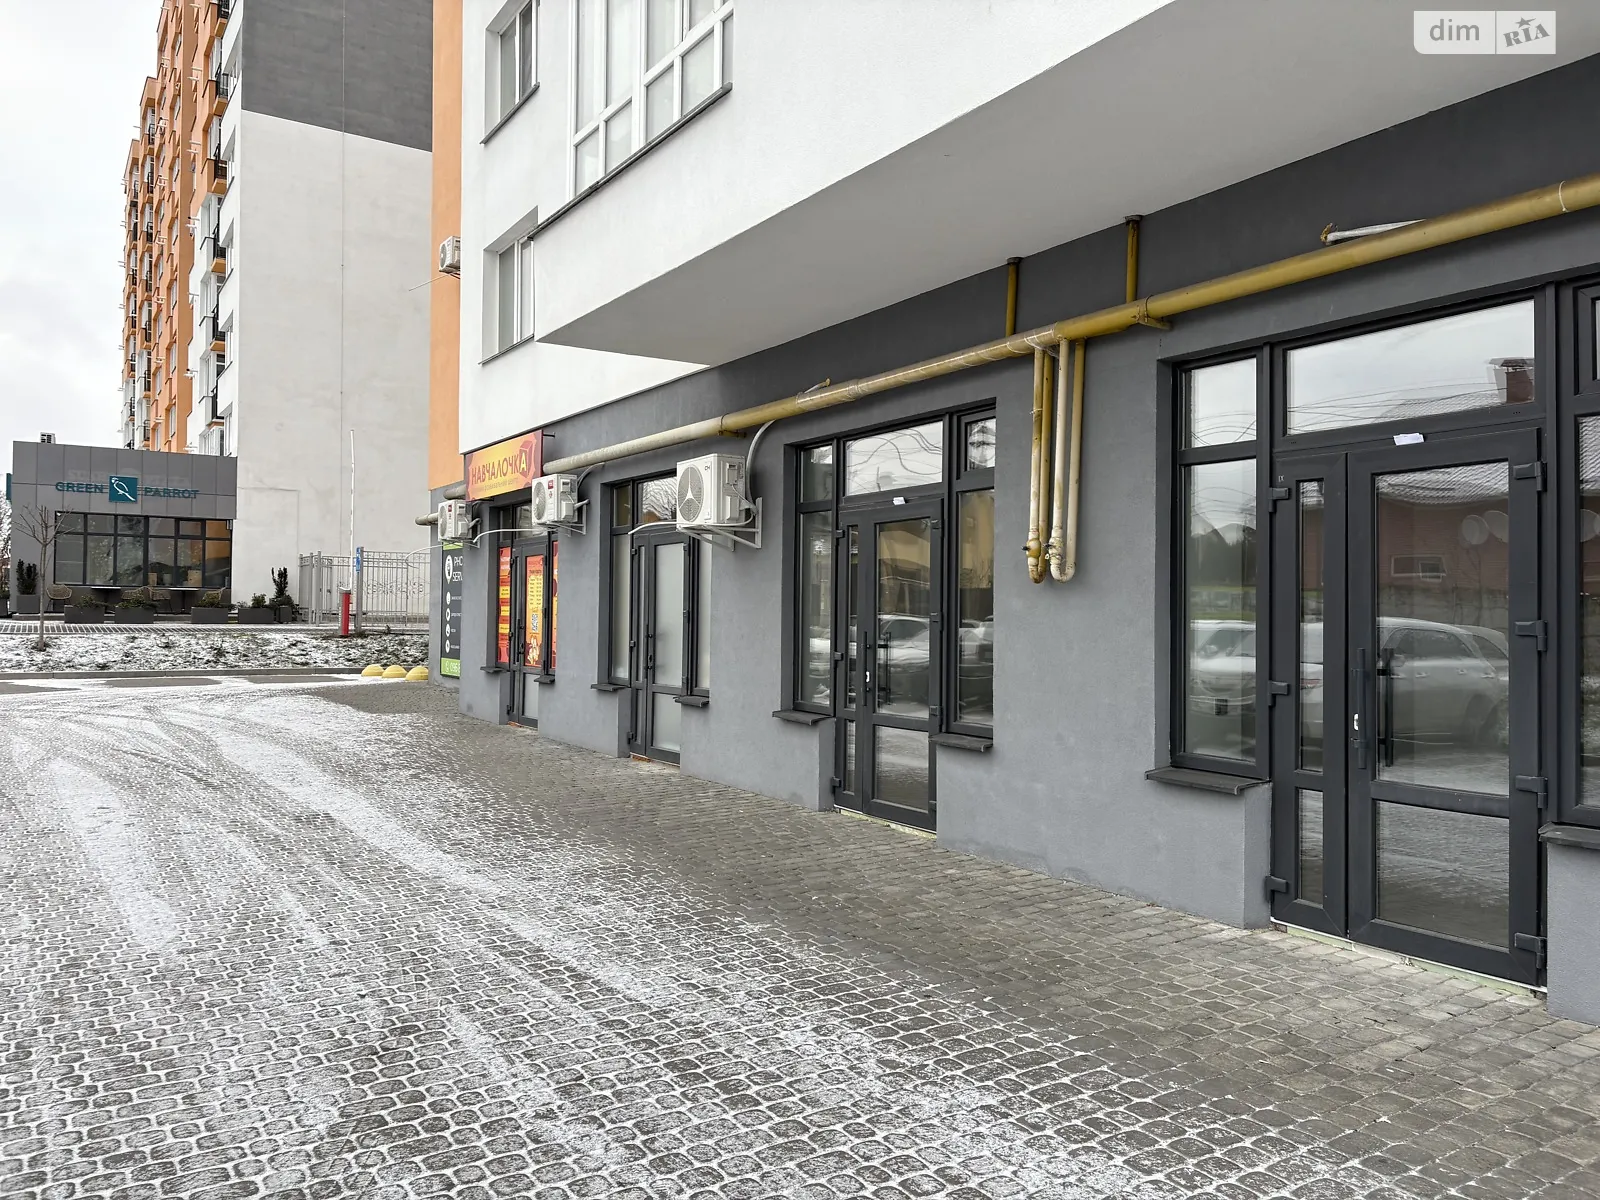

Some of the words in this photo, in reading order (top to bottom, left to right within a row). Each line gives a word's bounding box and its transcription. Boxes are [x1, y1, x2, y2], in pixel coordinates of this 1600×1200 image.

[471, 451, 527, 485] НАВЧАЛОЧКА
[55, 481, 104, 493] GREEN
[144, 486, 199, 499] PARROT
